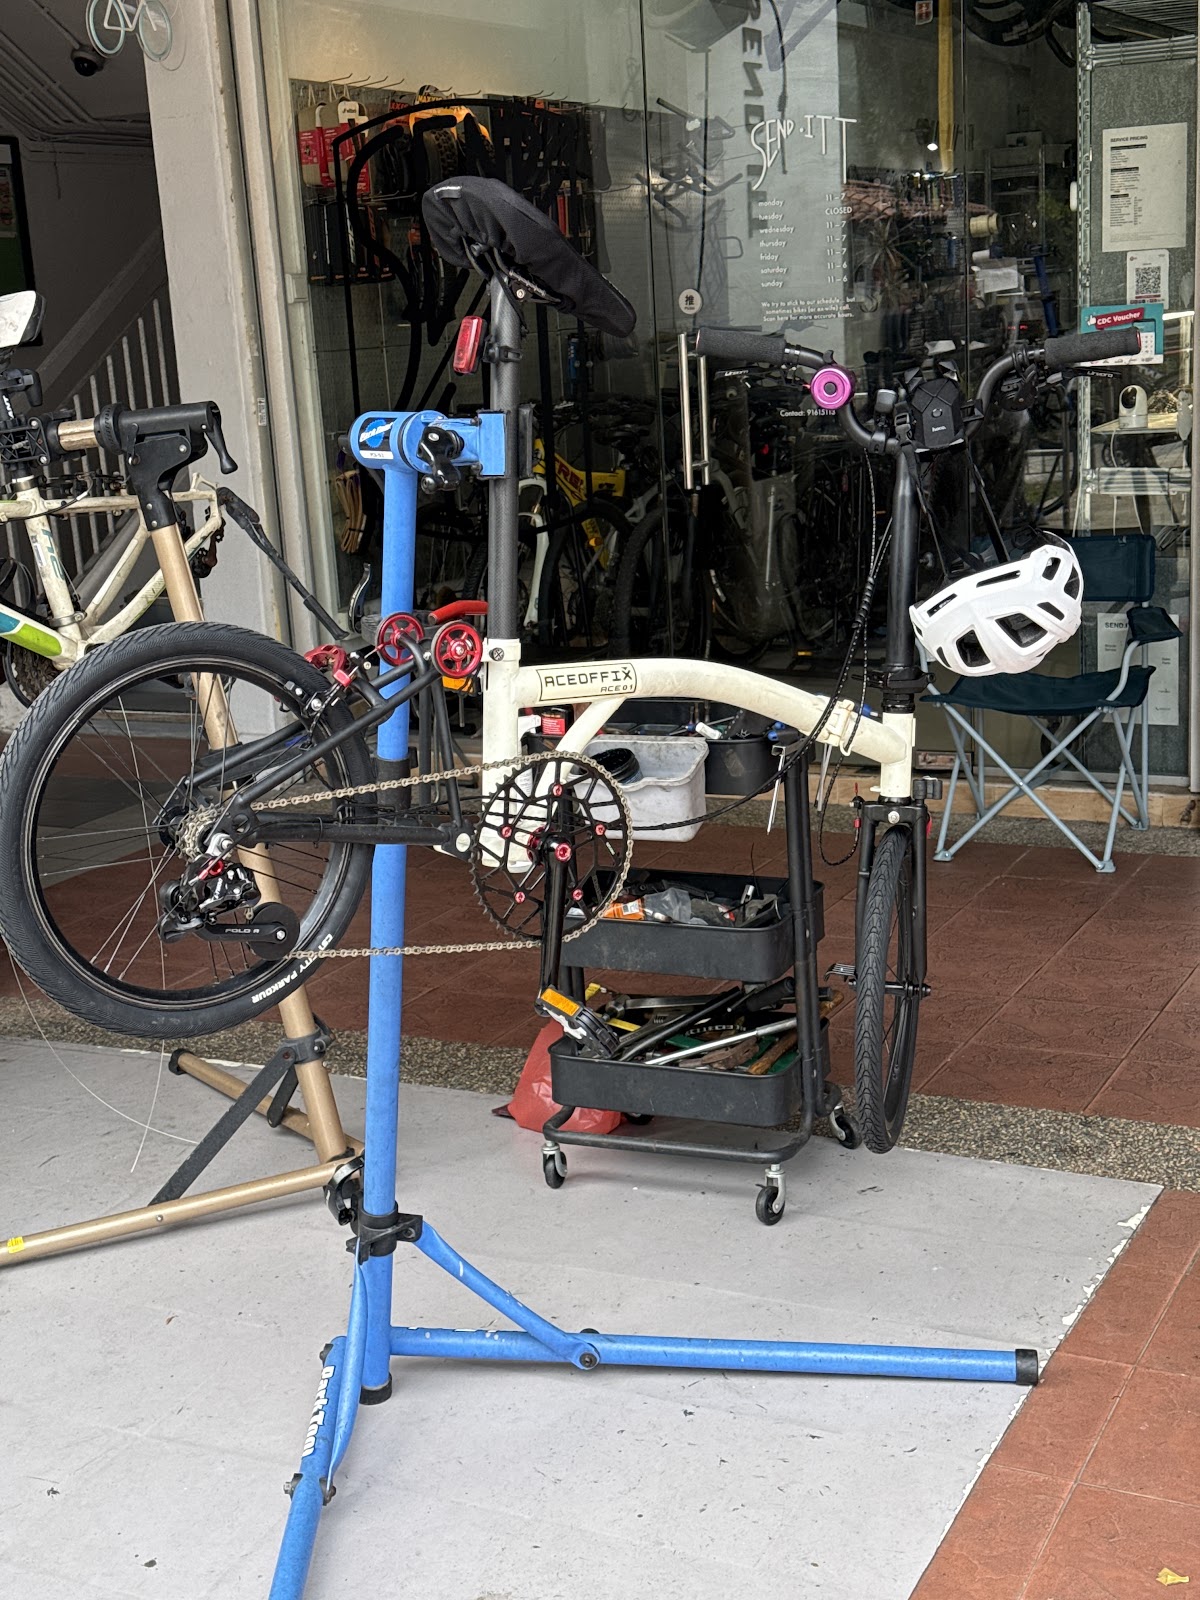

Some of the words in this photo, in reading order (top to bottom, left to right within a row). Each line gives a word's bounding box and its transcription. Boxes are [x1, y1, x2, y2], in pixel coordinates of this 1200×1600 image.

[758, 199, 784, 207] monday
[825, 206, 853, 215] CLOSED
[760, 225, 795, 233] wednesday
[760, 239, 787, 247] thursday
[760, 253, 779, 261] friday
[761, 280, 783, 288] sunday
[685, 294, 694, 305] 推
[1097, 316, 1112, 326] CDC
[1113, 311, 1141, 323] Voucher
[544, 669, 633, 687] ACEOFFIX
[251, 970, 298, 1004] PARKOUR
